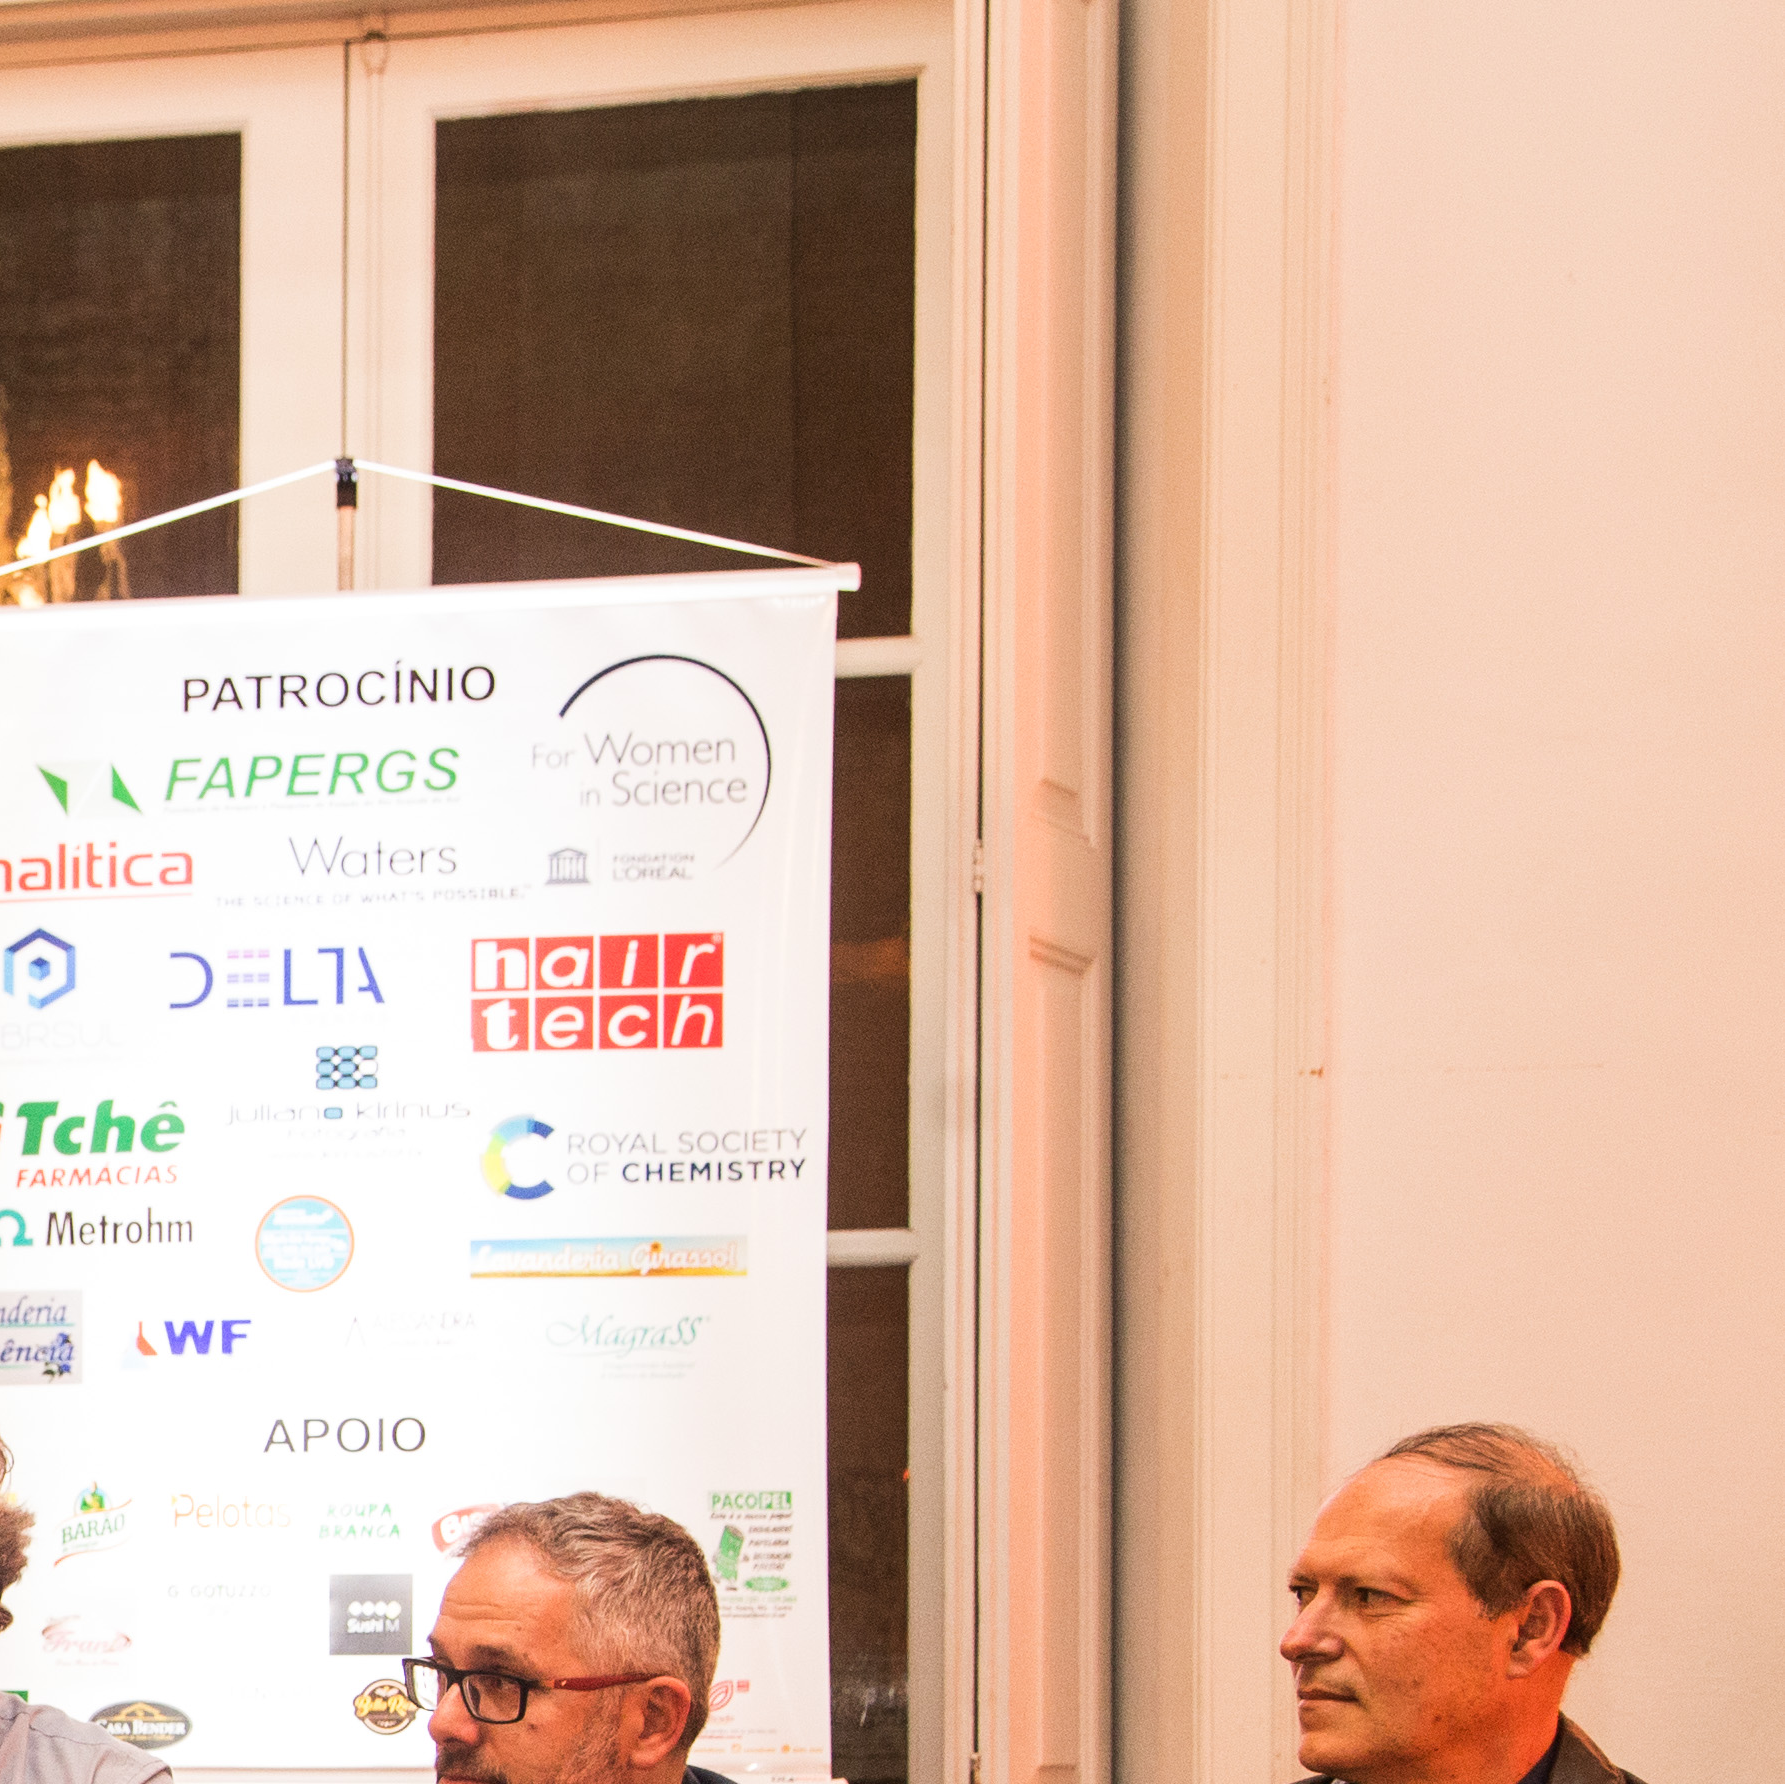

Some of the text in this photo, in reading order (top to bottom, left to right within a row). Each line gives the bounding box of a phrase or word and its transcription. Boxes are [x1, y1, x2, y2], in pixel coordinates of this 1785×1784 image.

[182, 657, 498, 715] PATROCÍNIO
[531, 730, 737, 770] For Women
[163, 746, 462, 802] FAPERGS
[579, 768, 749, 808] in Science
[287, 834, 459, 880] Waters
[215, 896, 246, 909] THE
[253, 894, 324, 908] SCIENCE
[331, 892, 354, 906] OF
[168, 945, 387, 1010] DELTA
[474, 941, 715, 990] hair
[481, 996, 714, 1051] tech
[14, 1097, 186, 1158] Tchê
[566, 1127, 809, 1156] ROYAL SOCIETY
[14, 1160, 179, 1190] FARMÁCIAS
[566, 1156, 808, 1185] OF CHEMISTRY
[44, 1205, 195, 1248] Metrohm
[476, 1245, 622, 1272] Lavanderia
[163, 1318, 253, 1356] WF
[262, 1416, 427, 1454] APOIO
[173, 1493, 292, 1530] Pelotas
[327, 1503, 393, 1518] ROUPA
[711, 1491, 792, 1510] PACOPEL
[61, 1511, 126, 1545] BARÃO
[319, 1524, 401, 1540] BRANCA
